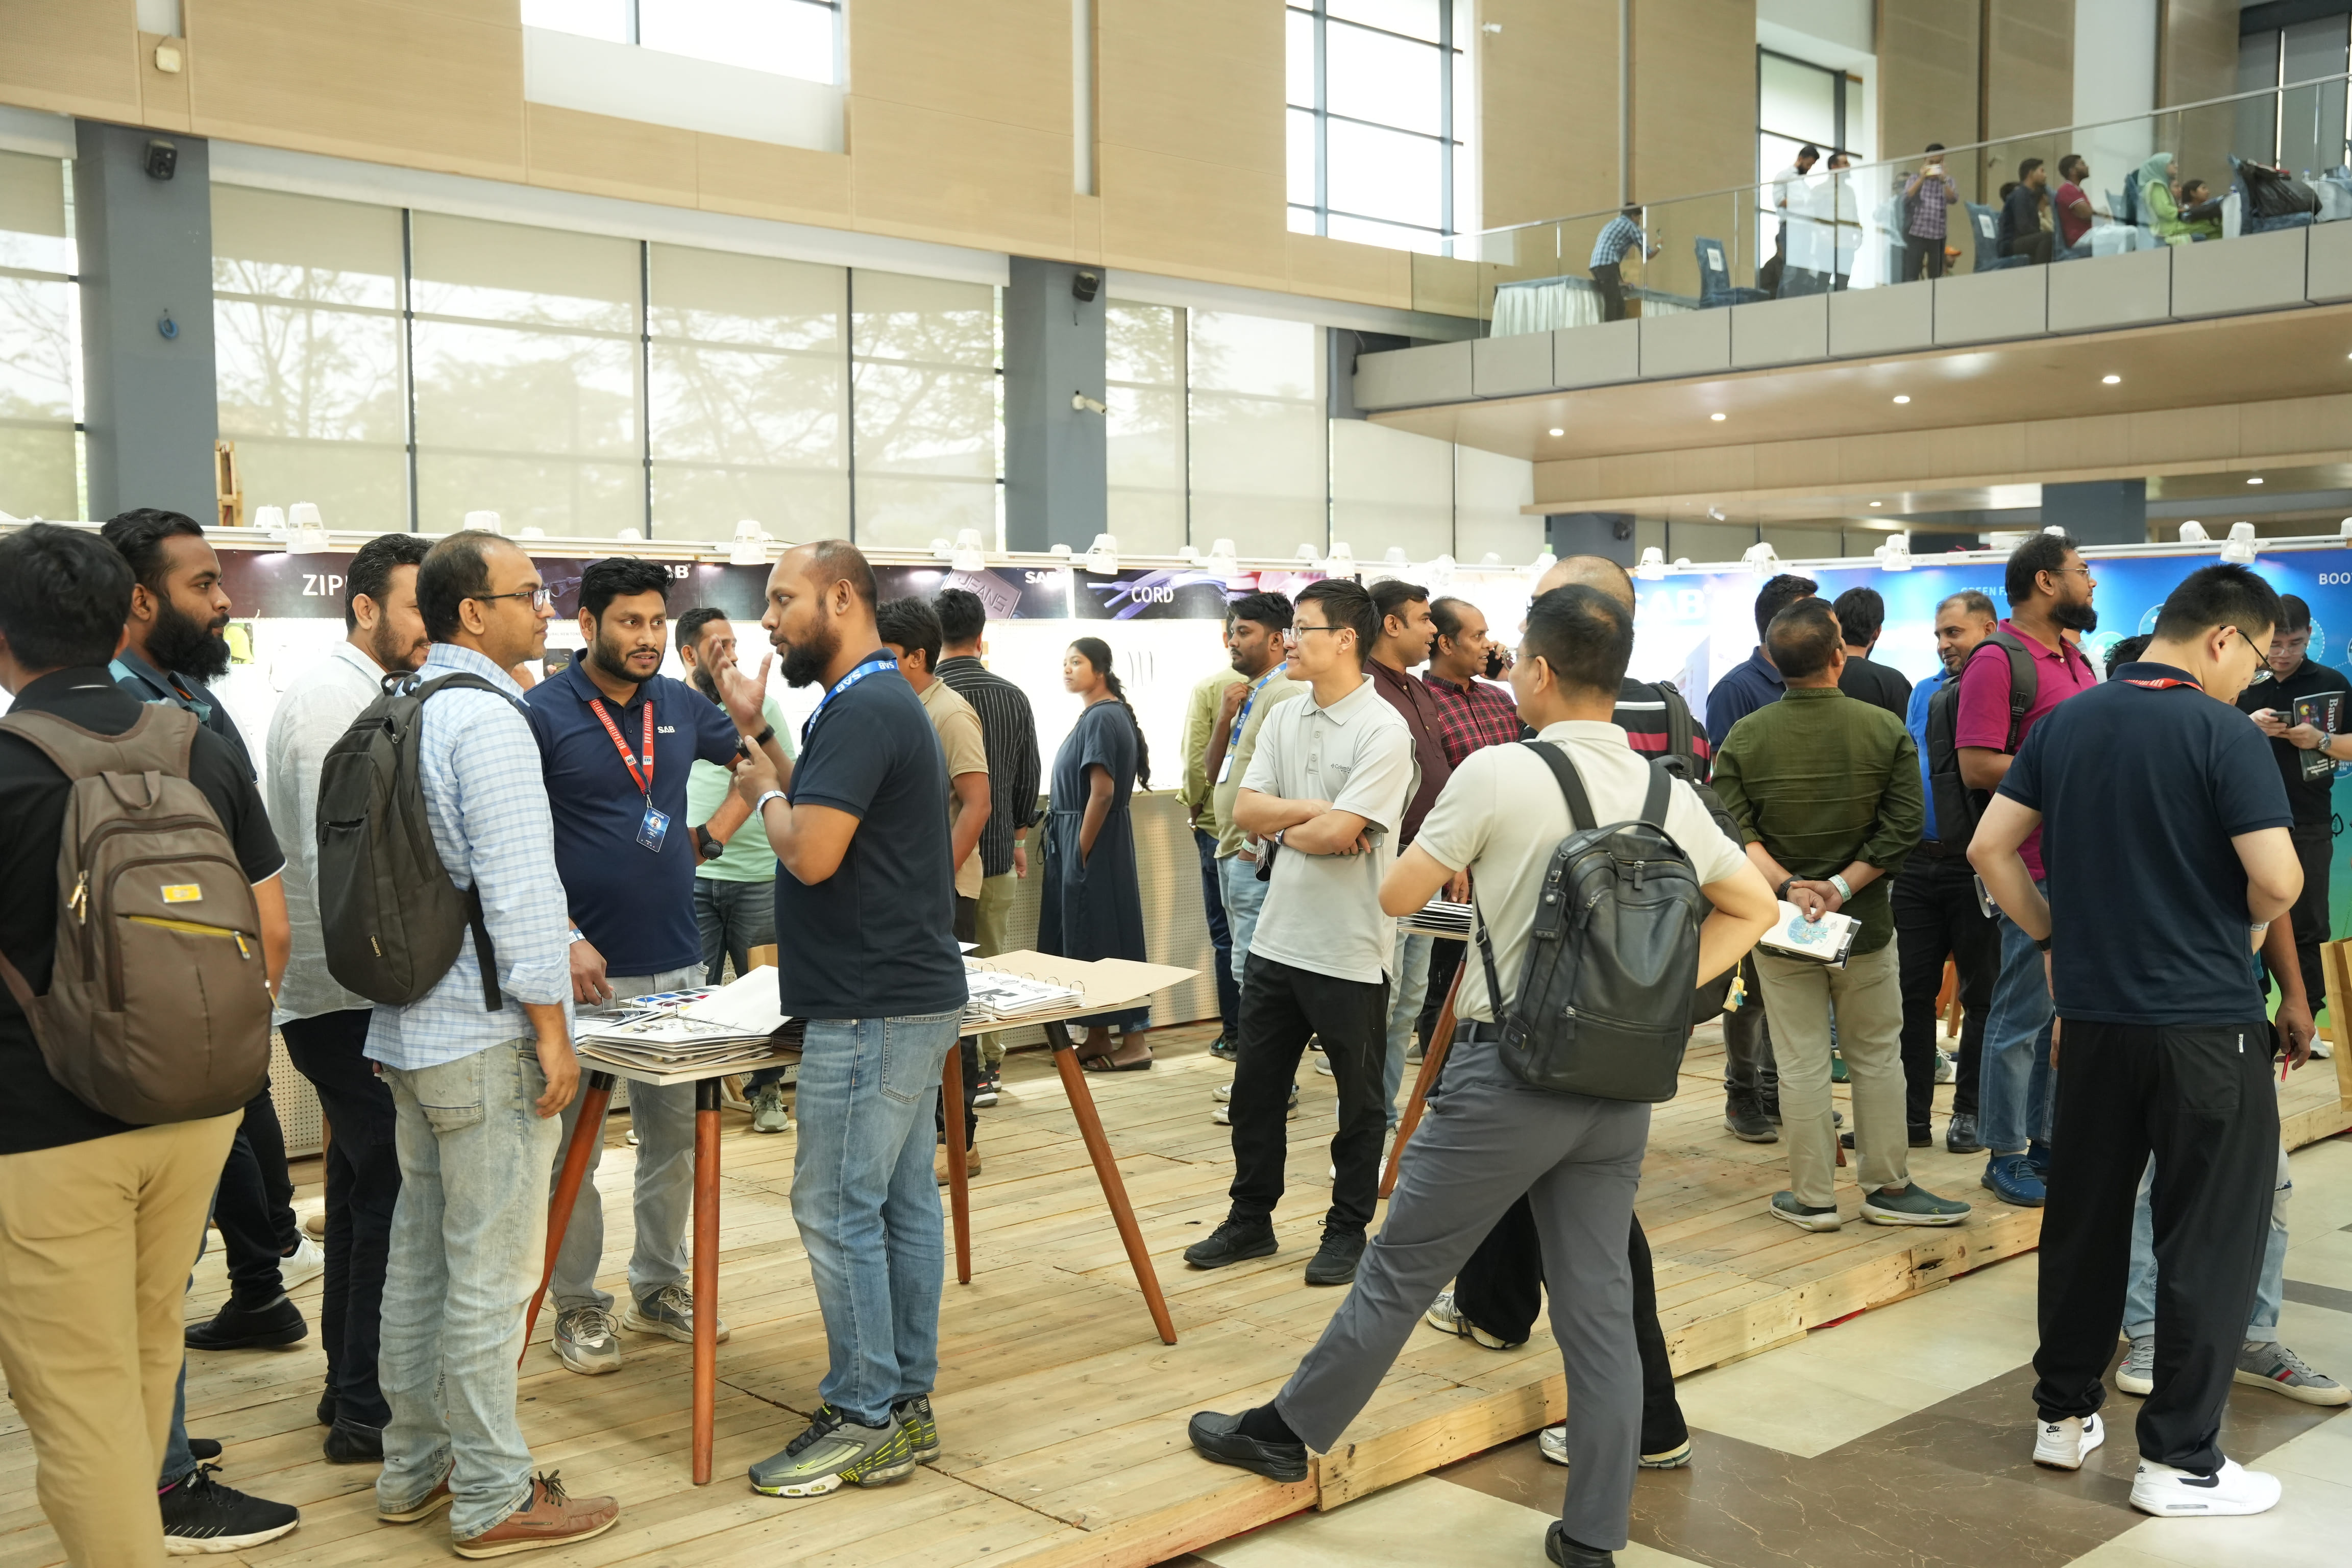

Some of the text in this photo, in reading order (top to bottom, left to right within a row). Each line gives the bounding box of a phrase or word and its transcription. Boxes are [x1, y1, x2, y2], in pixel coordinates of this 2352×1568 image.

[302, 574, 348, 596] ZIP
[2319, 572, 2352, 585] BOO
[958, 575, 1008, 614] JEANS
[1131, 586, 1173, 603] CORD
[836, 669, 862, 693] SAB
[1266, 667, 1281, 680] SAB
[657, 725, 676, 734] SAB
[1237, 713, 1246, 730] SAB
[371, 937, 381, 957] Lenovo
